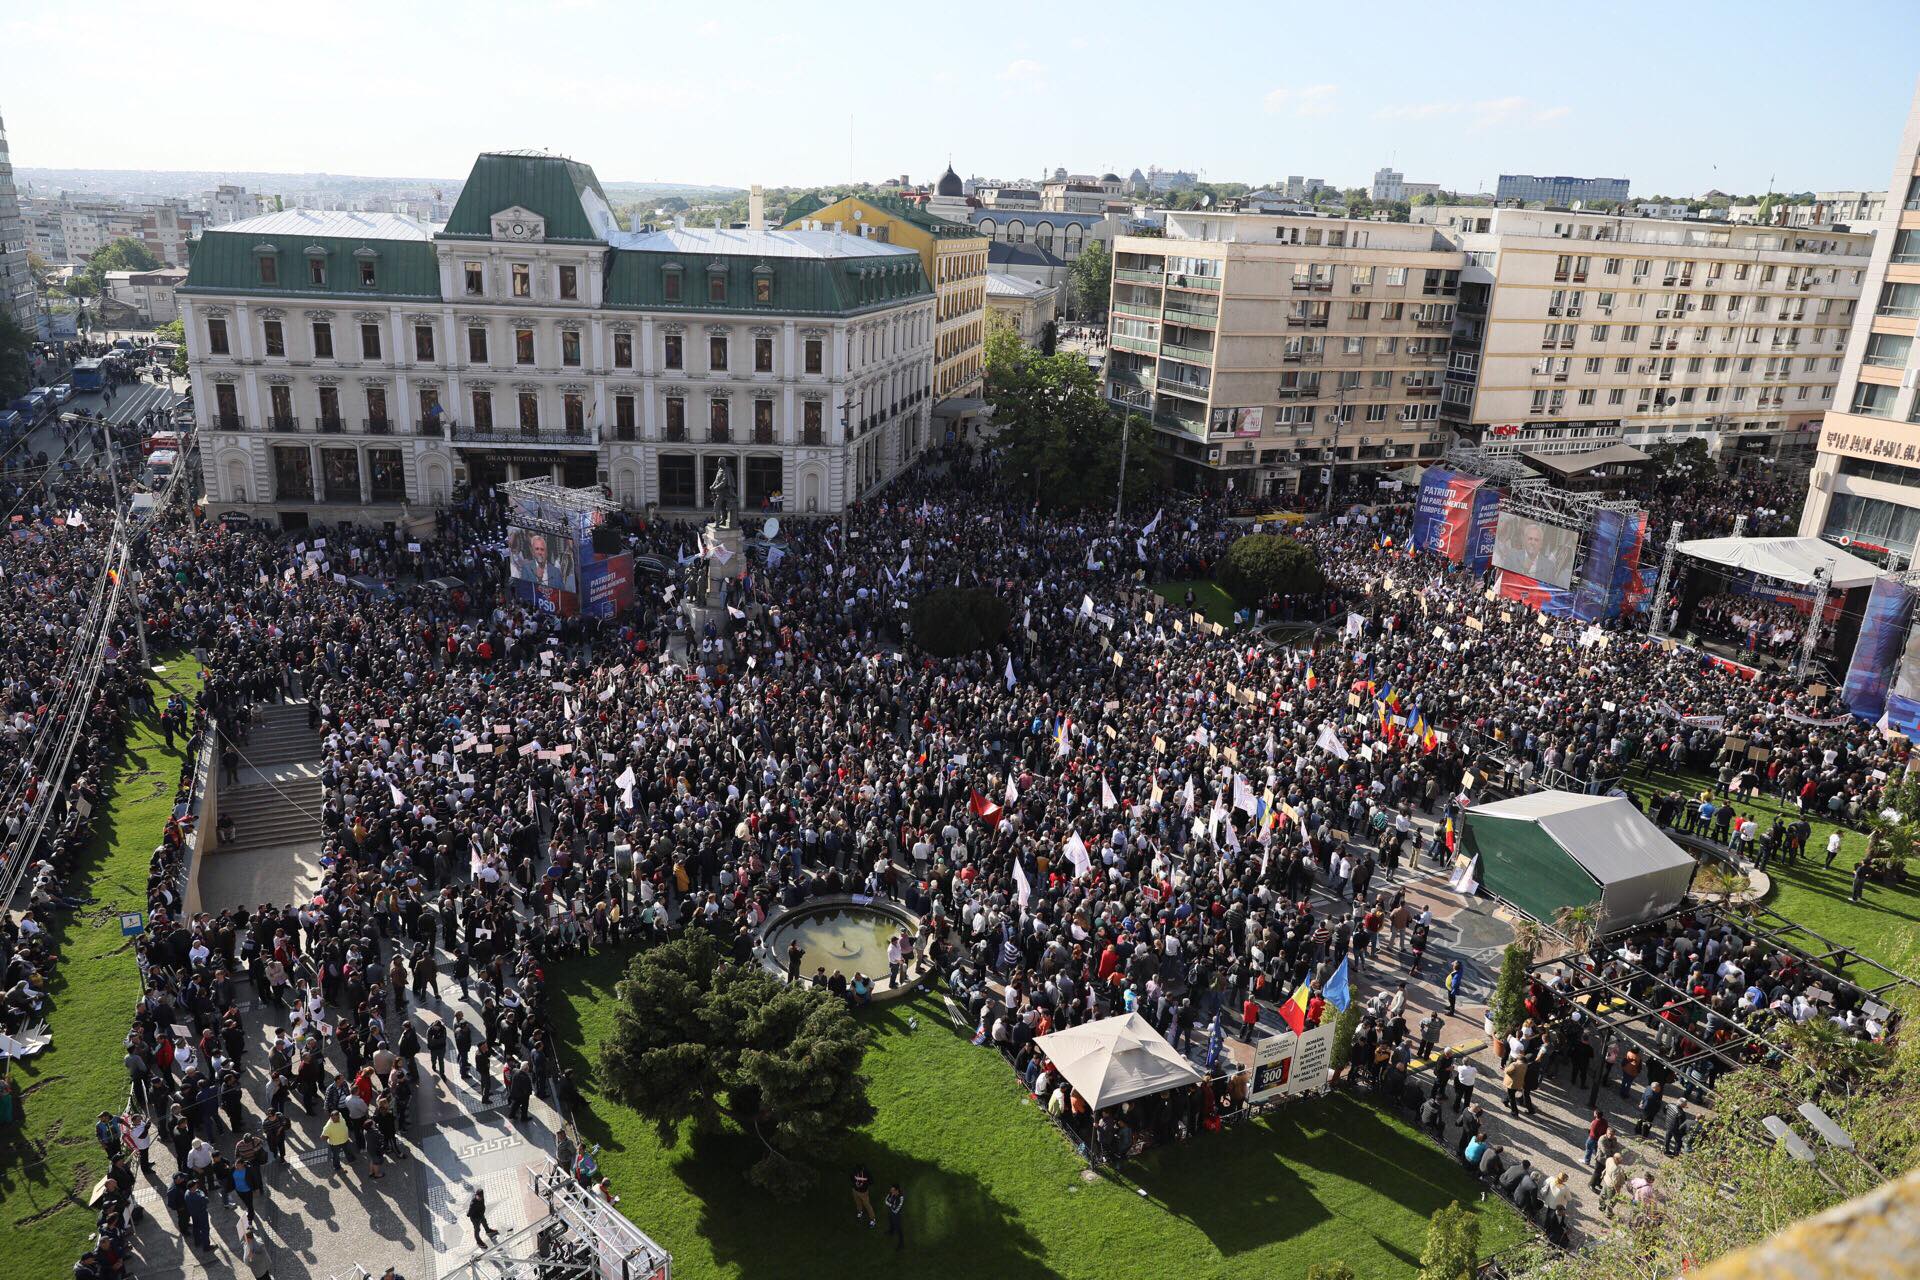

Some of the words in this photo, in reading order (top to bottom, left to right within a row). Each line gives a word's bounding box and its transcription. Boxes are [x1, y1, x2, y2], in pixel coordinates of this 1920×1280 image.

[1428, 497, 1468, 510] PARLAMENTUL
[1420, 505, 1449, 516] EUROPEAN
[1430, 536, 1444, 548] PSD
[538, 598, 556, 612] PSD
[1262, 1068, 1282, 1084] 300
